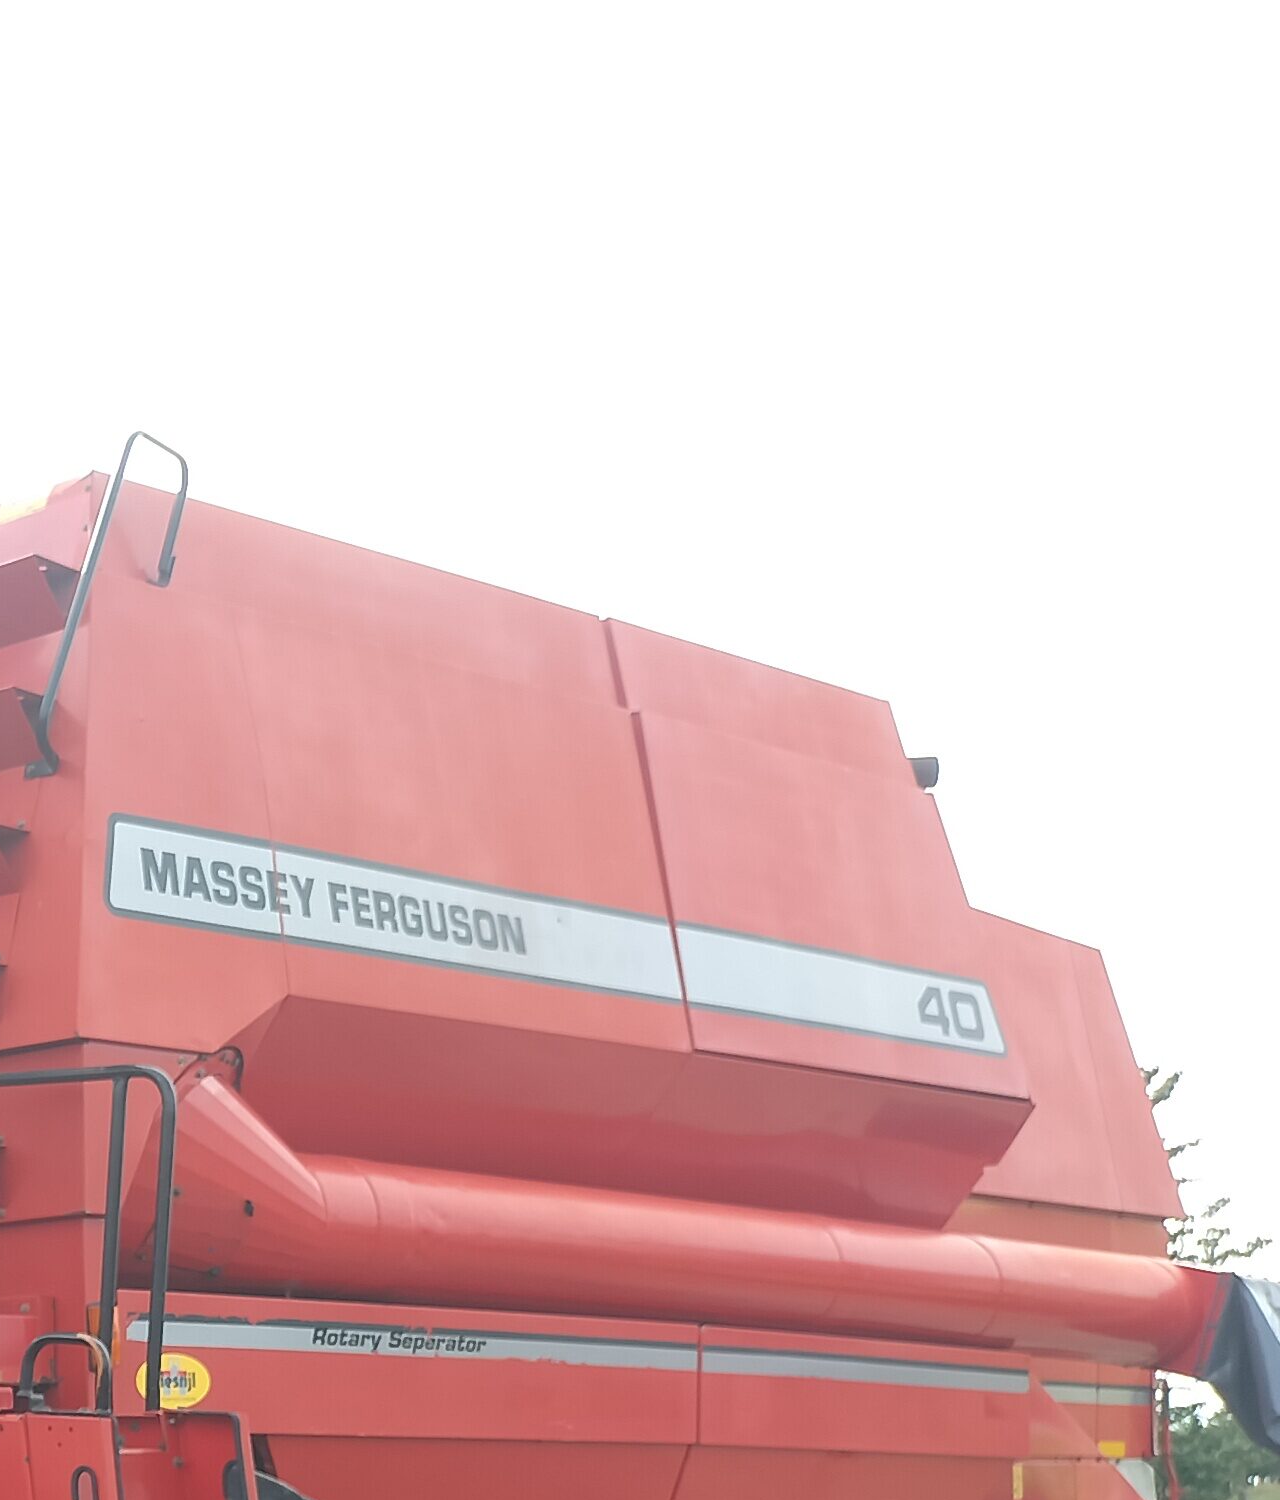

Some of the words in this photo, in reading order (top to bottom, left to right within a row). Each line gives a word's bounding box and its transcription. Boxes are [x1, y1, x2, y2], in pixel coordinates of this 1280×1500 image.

[140, 847, 315, 918] MASSEY
[327, 882, 527, 955] FERGUSON
[917, 985, 985, 1042] 40
[312, 1327, 382, 1353] Rotary
[388, 1330, 487, 1354] Separator
